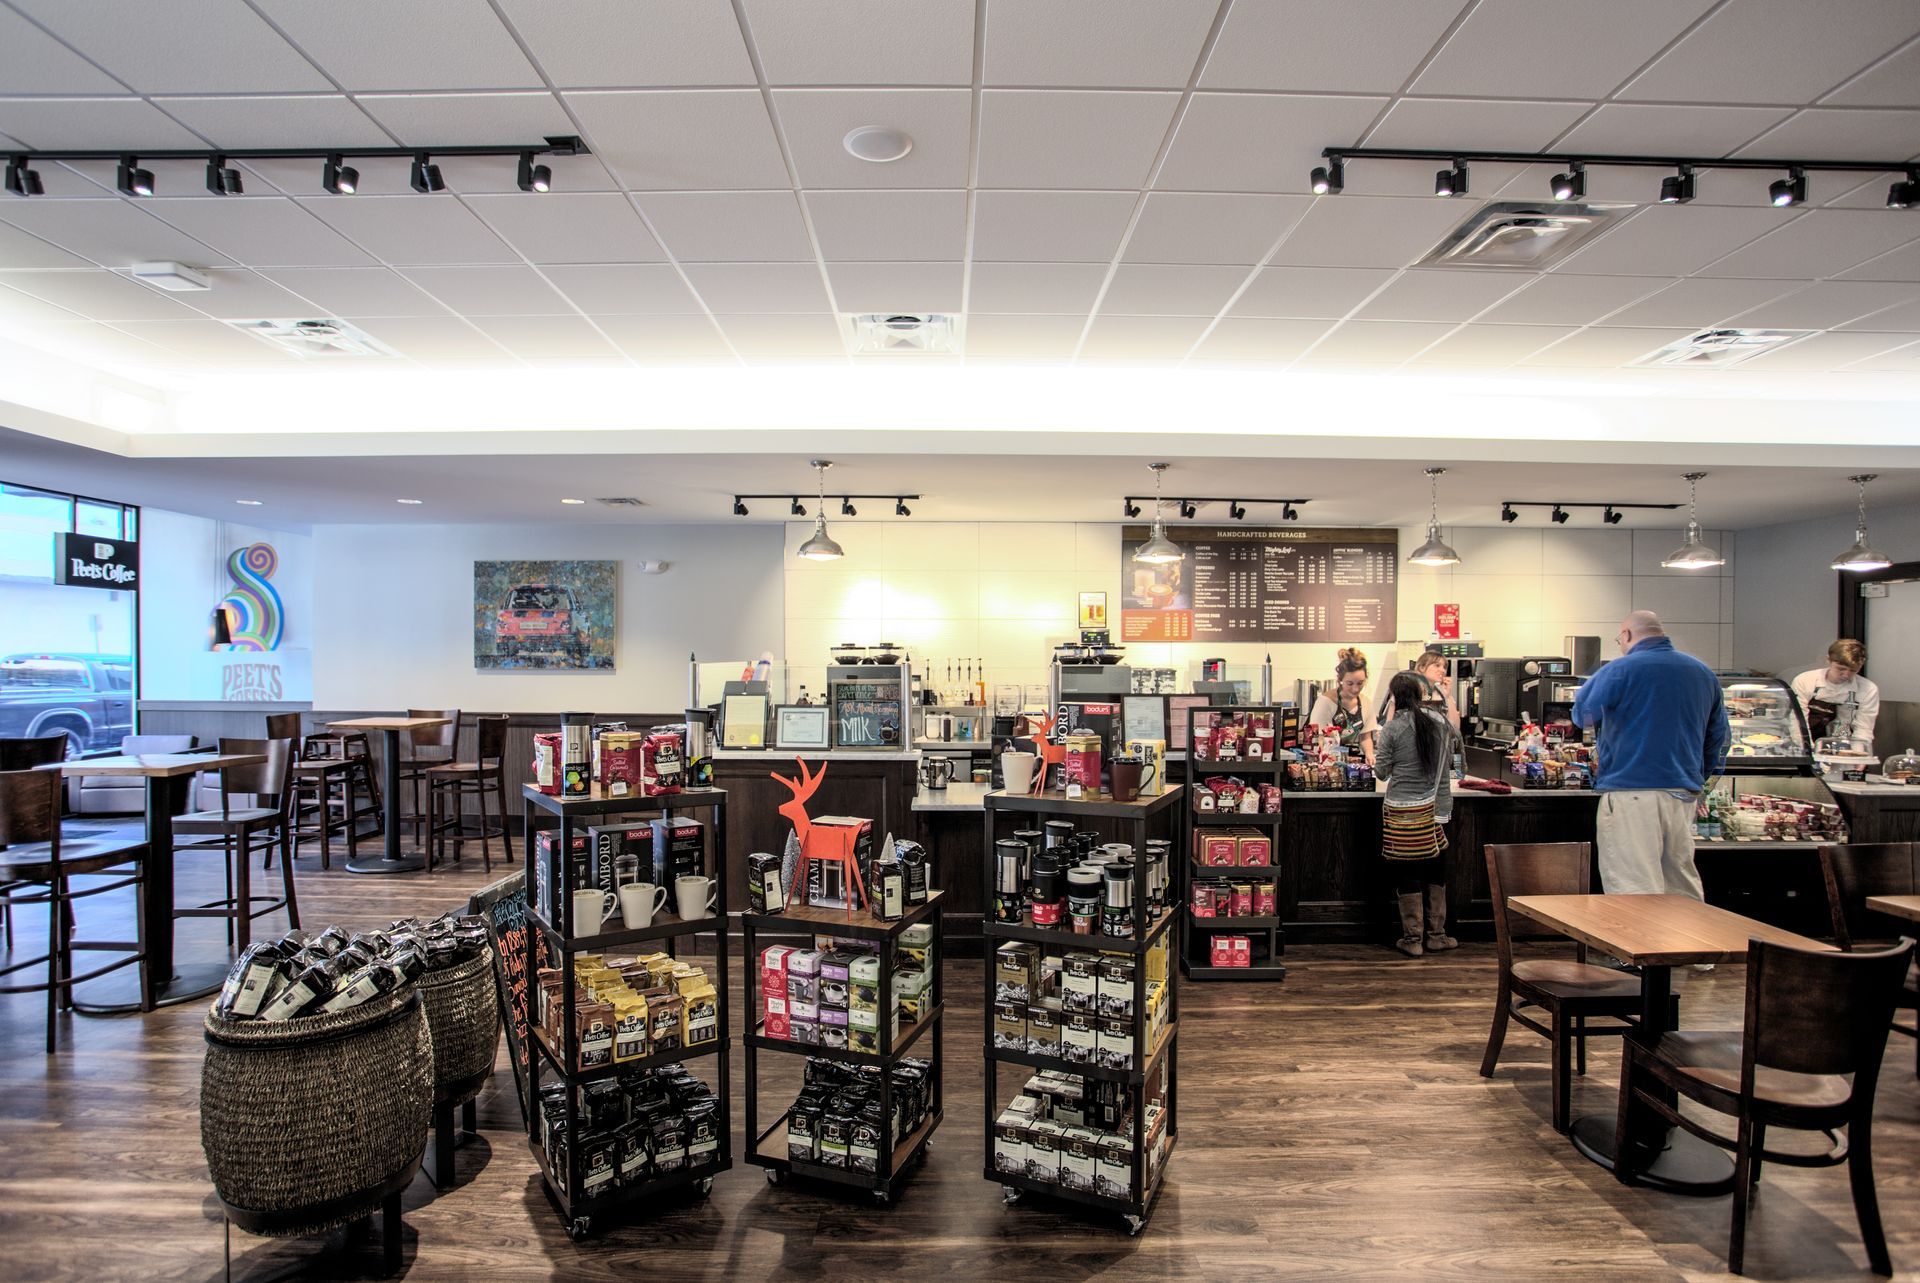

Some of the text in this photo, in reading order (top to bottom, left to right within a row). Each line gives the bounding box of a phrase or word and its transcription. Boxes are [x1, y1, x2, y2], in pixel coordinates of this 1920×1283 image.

[71, 558, 136, 584] Peet's Coffee
[222, 664, 283, 700] PEET'S
[630, 1024, 645, 1032] Coffee
[664, 1019, 677, 1028] Coffee
[596, 1031, 610, 1040] Coffee
